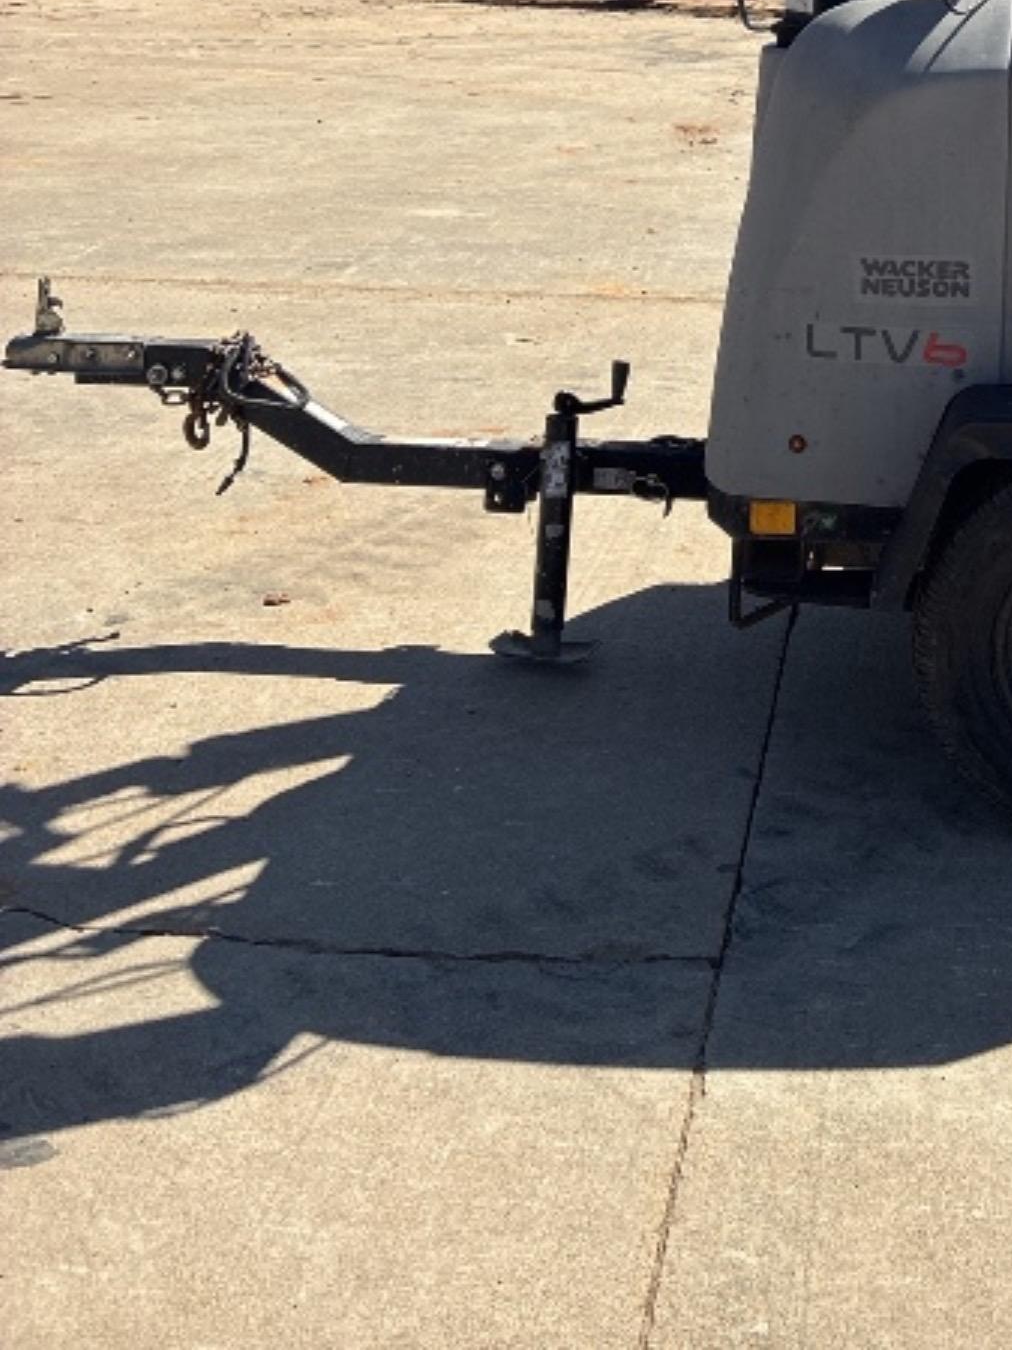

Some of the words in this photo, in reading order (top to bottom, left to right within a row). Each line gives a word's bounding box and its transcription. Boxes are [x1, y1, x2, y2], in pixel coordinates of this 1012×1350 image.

[860, 257, 970, 281] WACKER
[860, 277, 970, 299] NEUSON
[806, 323, 968, 368] LTV6
